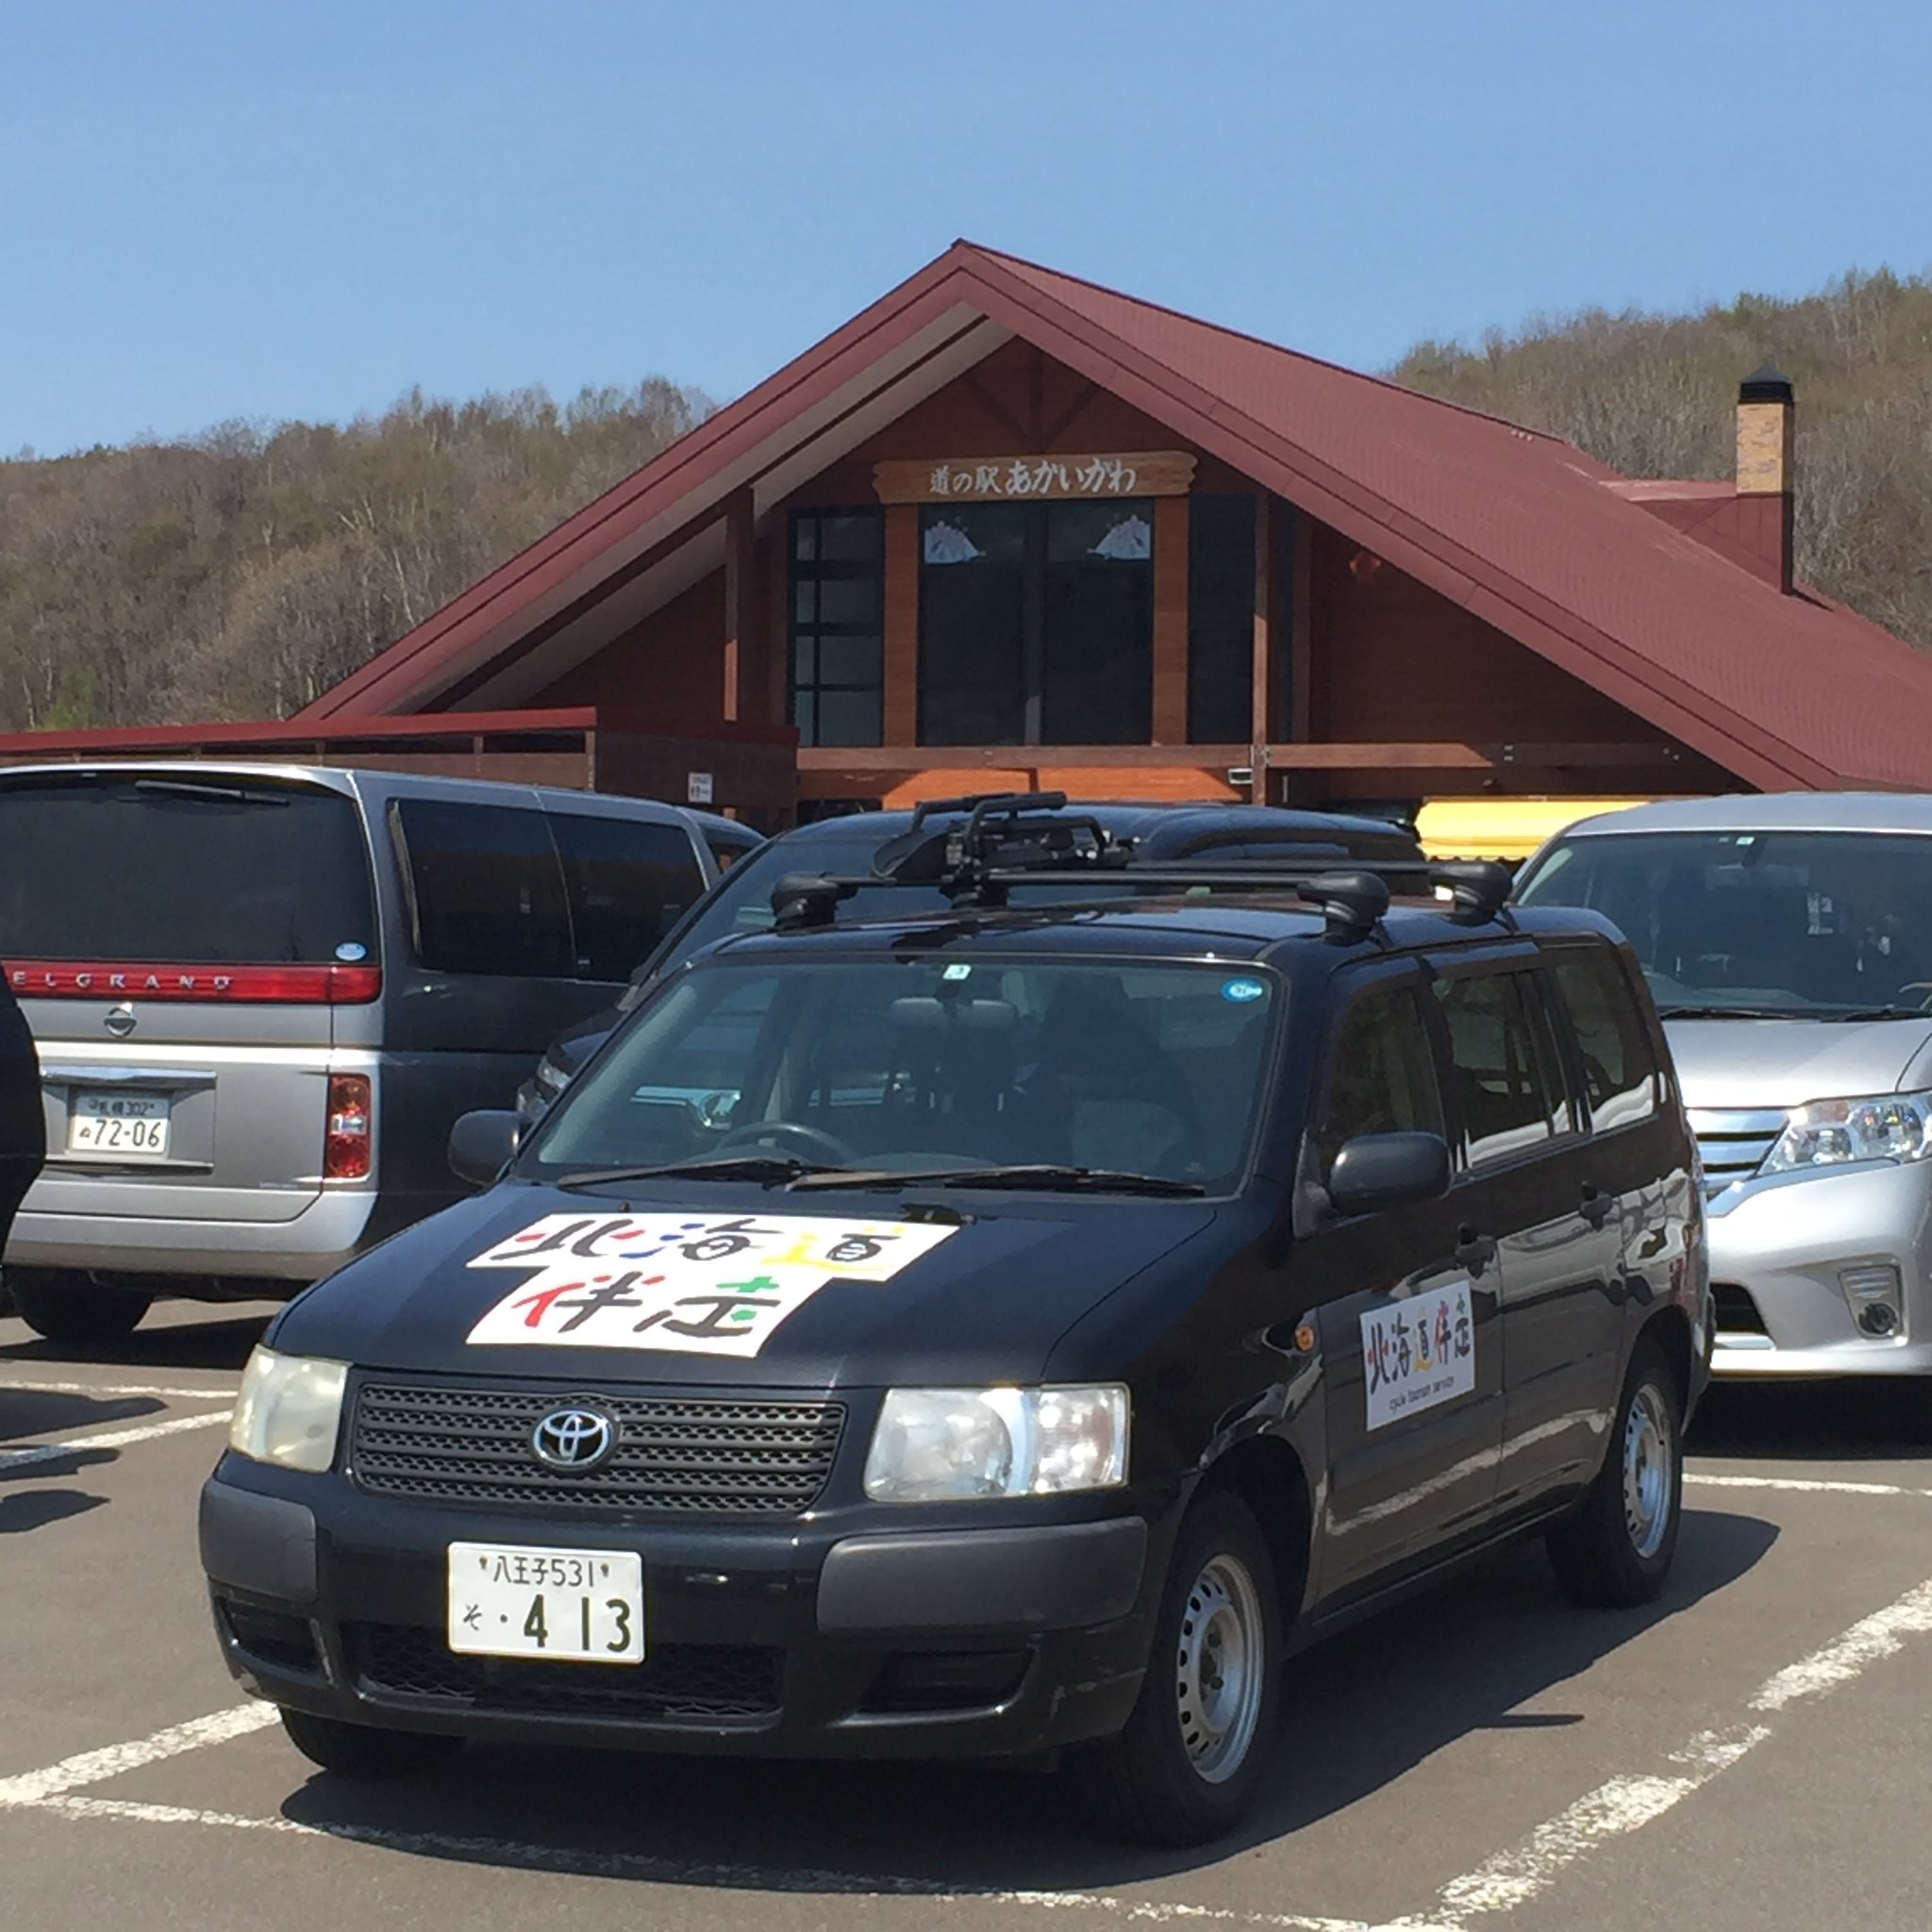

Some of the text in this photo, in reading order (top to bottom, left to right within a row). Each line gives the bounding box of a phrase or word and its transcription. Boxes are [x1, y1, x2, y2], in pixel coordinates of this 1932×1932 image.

[929, 458, 1137, 495] 道の駅あかいがわ
[12, 971, 233, 990] ELGRAND
[94, 1119, 161, 1147] 72-06
[490, 1218, 904, 1272] 北海道
[493, 1556, 594, 1588] 八王子531
